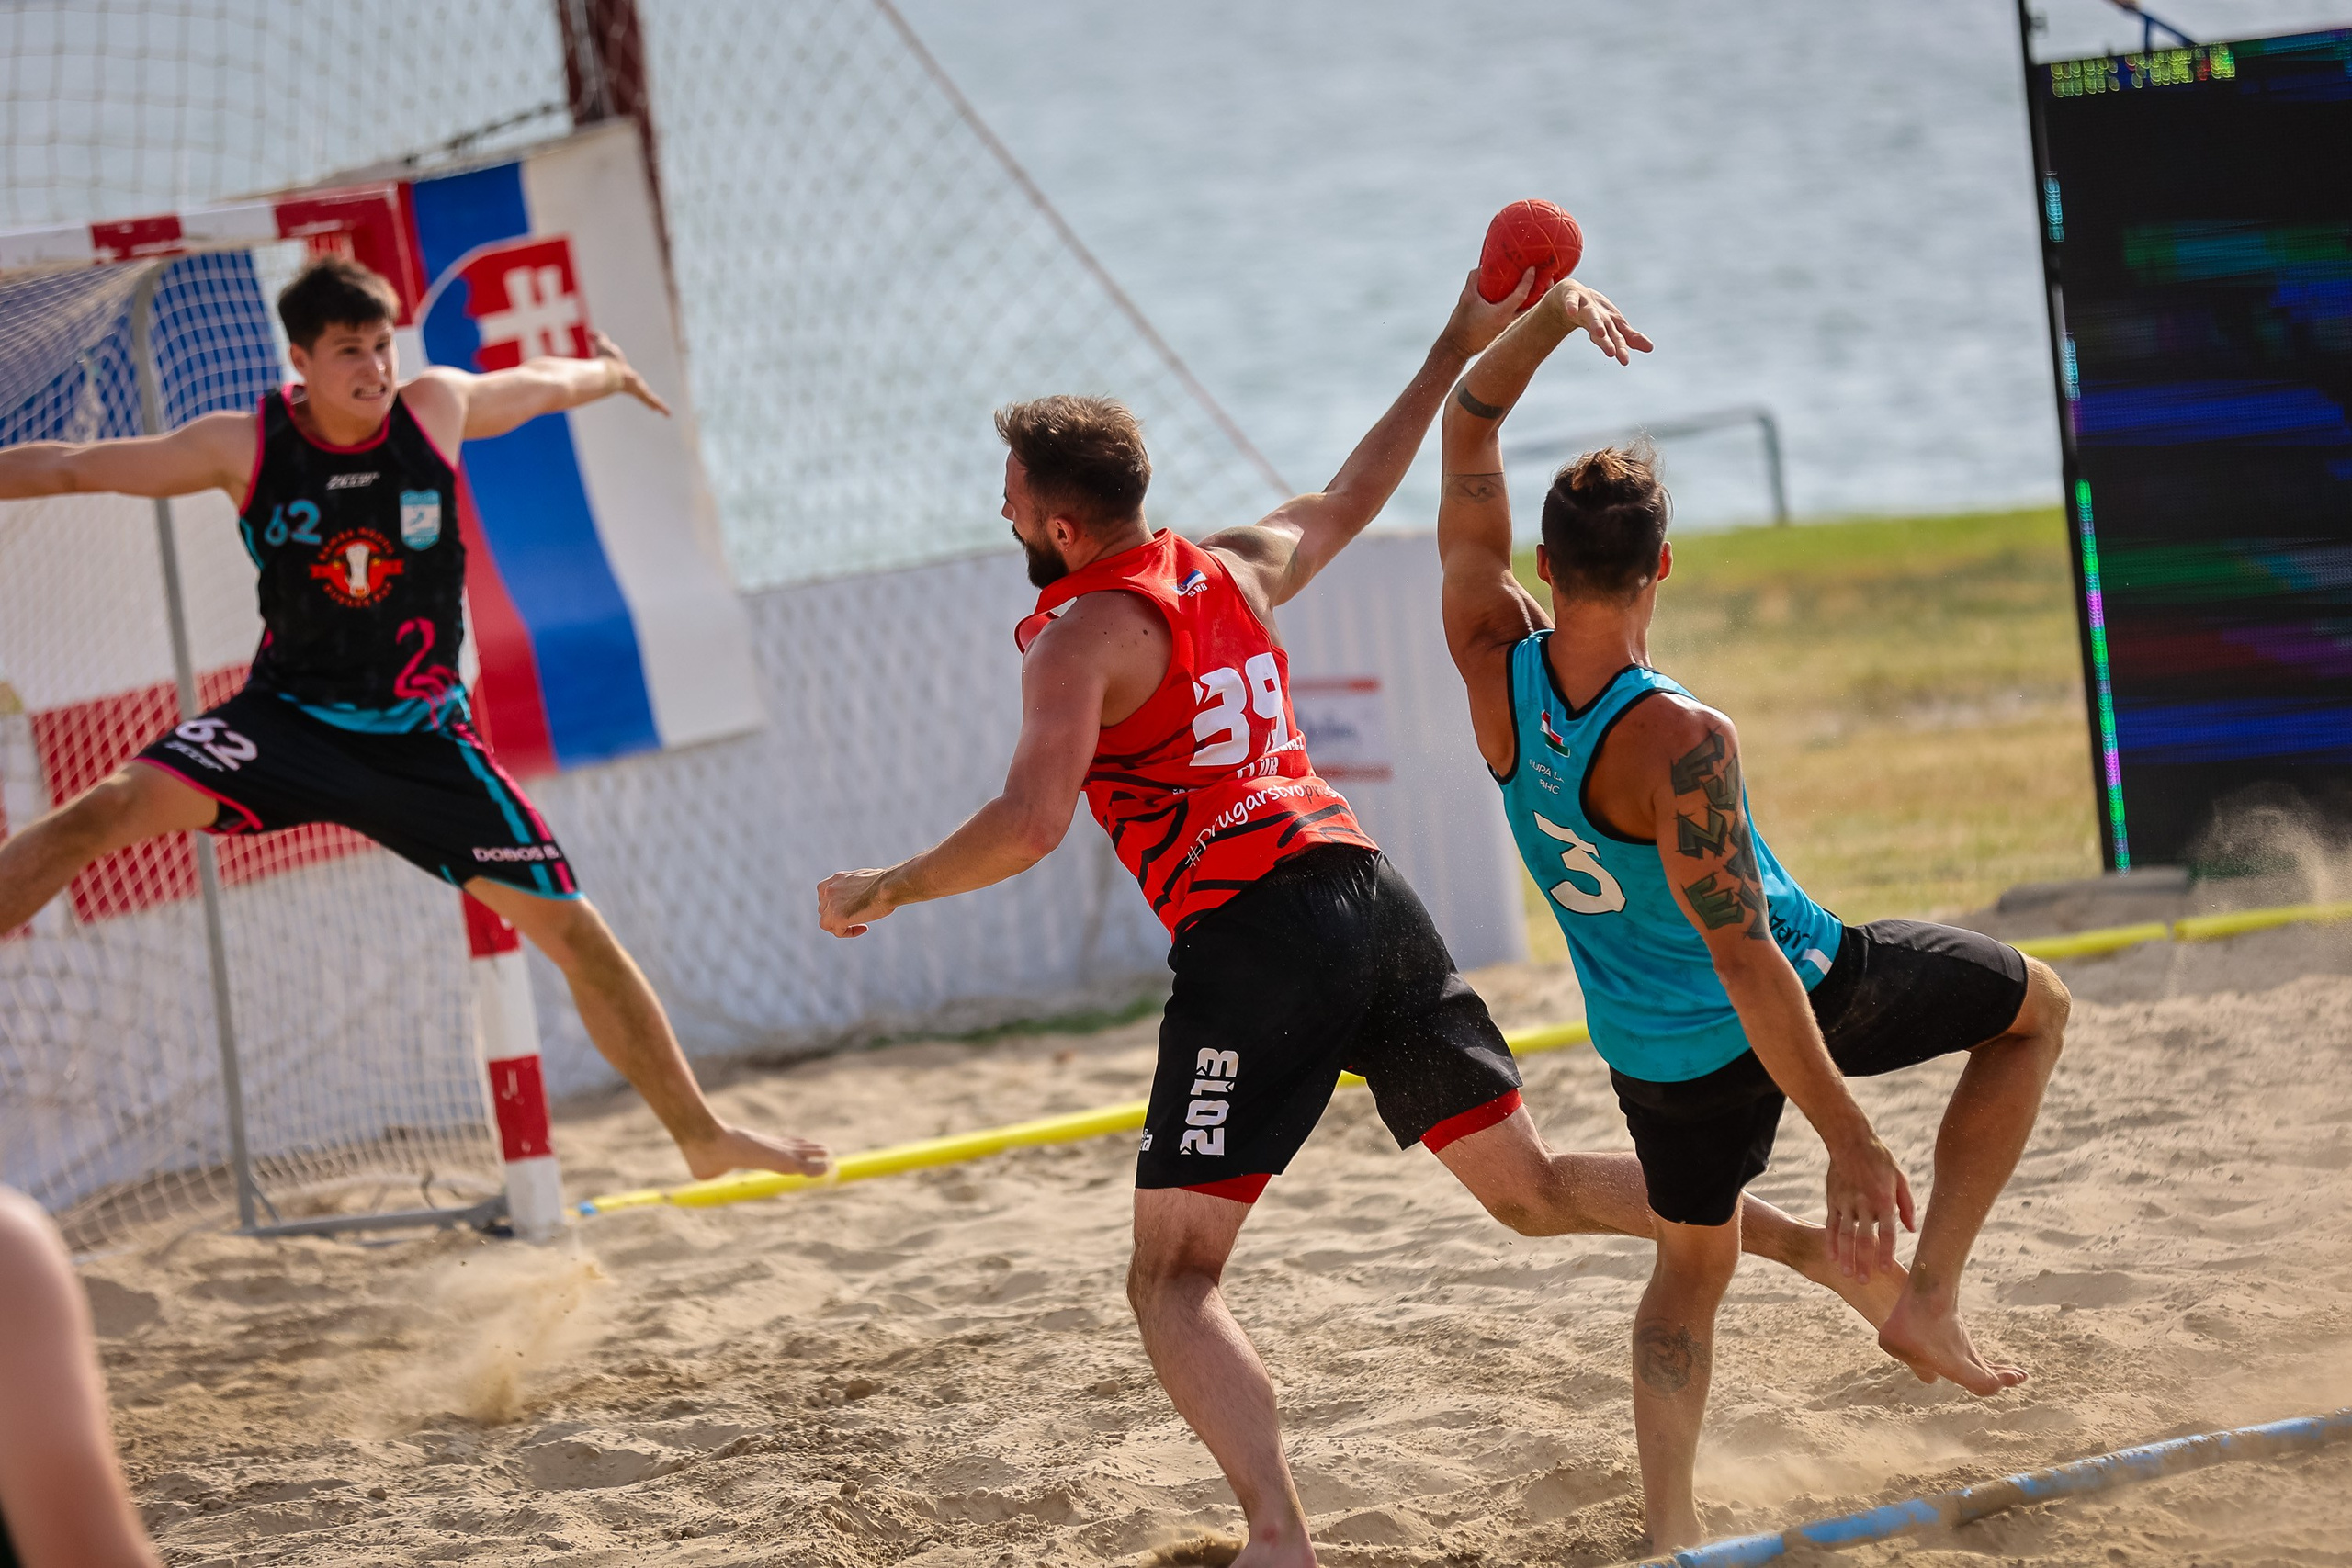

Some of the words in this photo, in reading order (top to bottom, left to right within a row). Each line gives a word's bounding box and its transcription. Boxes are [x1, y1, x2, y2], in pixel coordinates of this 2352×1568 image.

[264, 499, 322, 547] 62
[1187, 582, 1208, 597] SRB
[175, 718, 258, 771] 62
[1189, 651, 1290, 767] 39
[1532, 809, 1627, 915] 3
[1179, 1047, 1239, 1156] 2013
